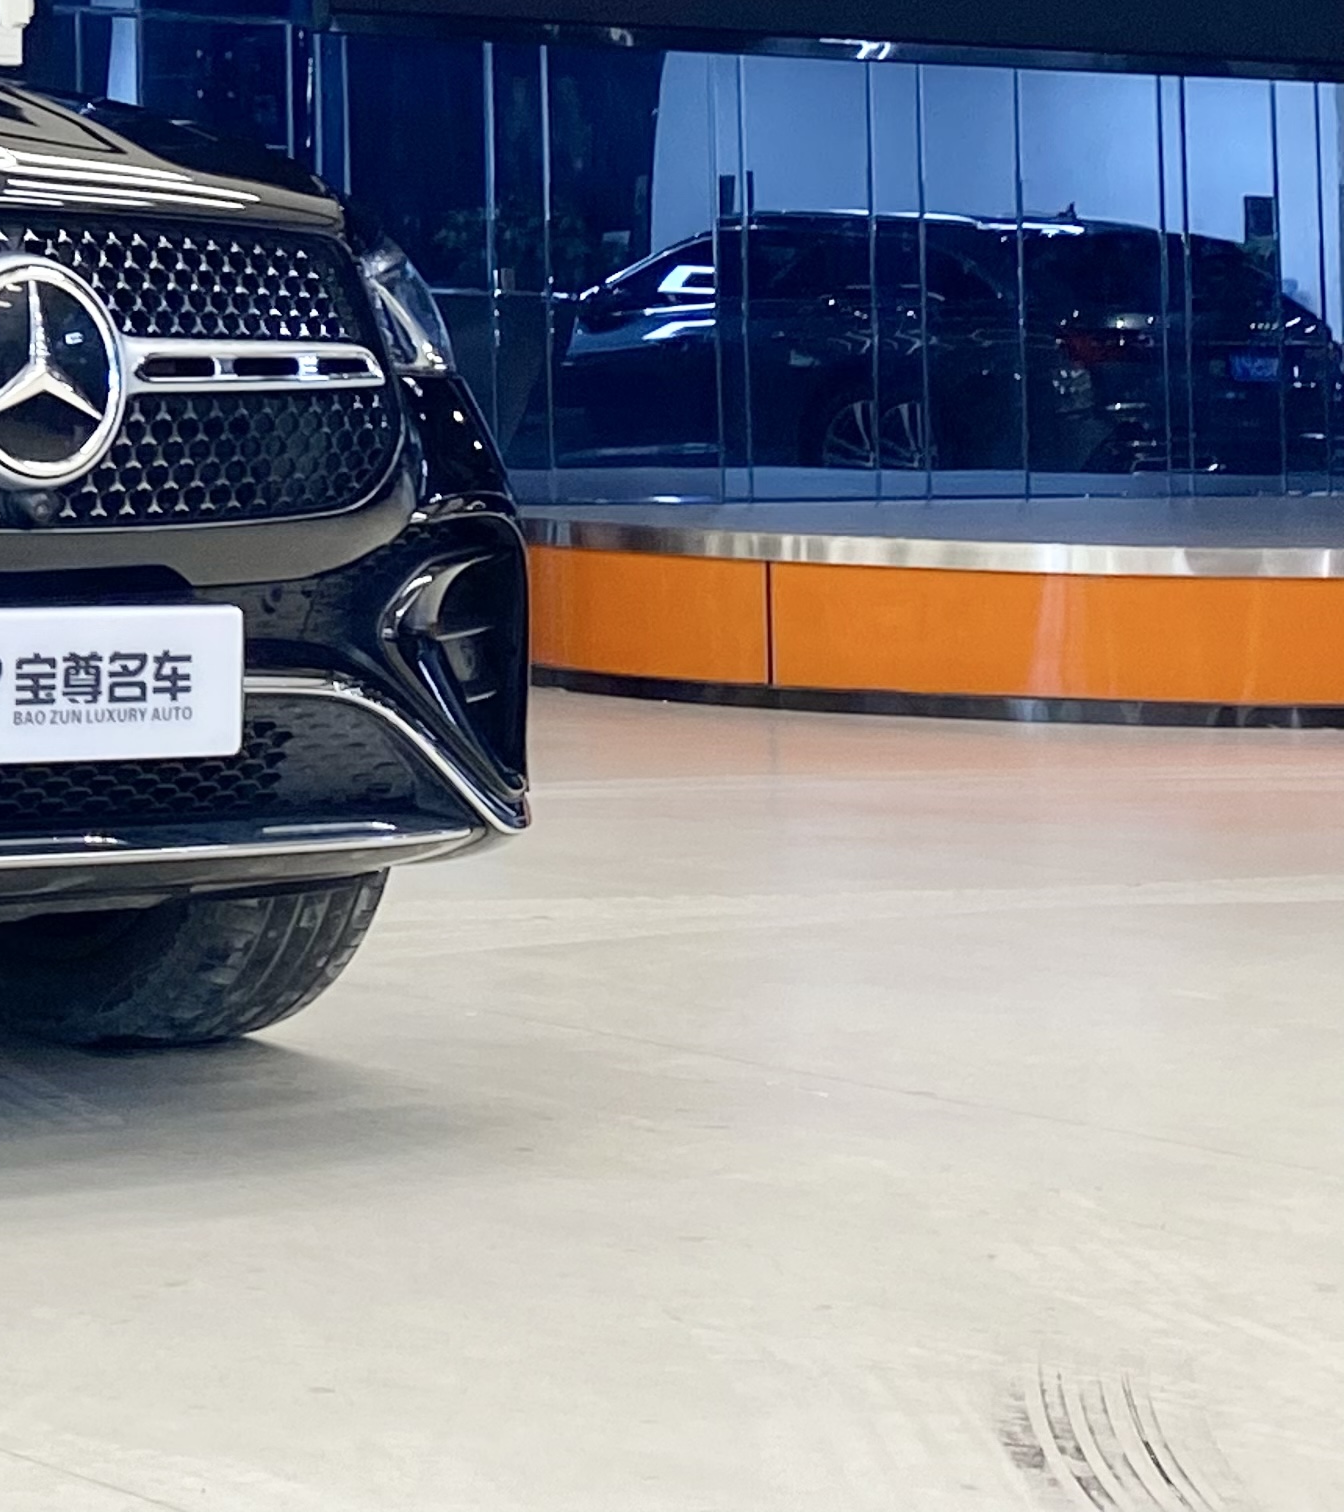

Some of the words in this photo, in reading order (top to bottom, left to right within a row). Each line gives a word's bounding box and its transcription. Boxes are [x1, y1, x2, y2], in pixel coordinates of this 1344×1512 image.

[15, 649, 192, 706] 宝尊名车
[13, 710, 46, 726] BAO
[50, 709, 82, 725] ZUN
[86, 708, 147, 724] LUXURY
[151, 706, 193, 721] AUTO
